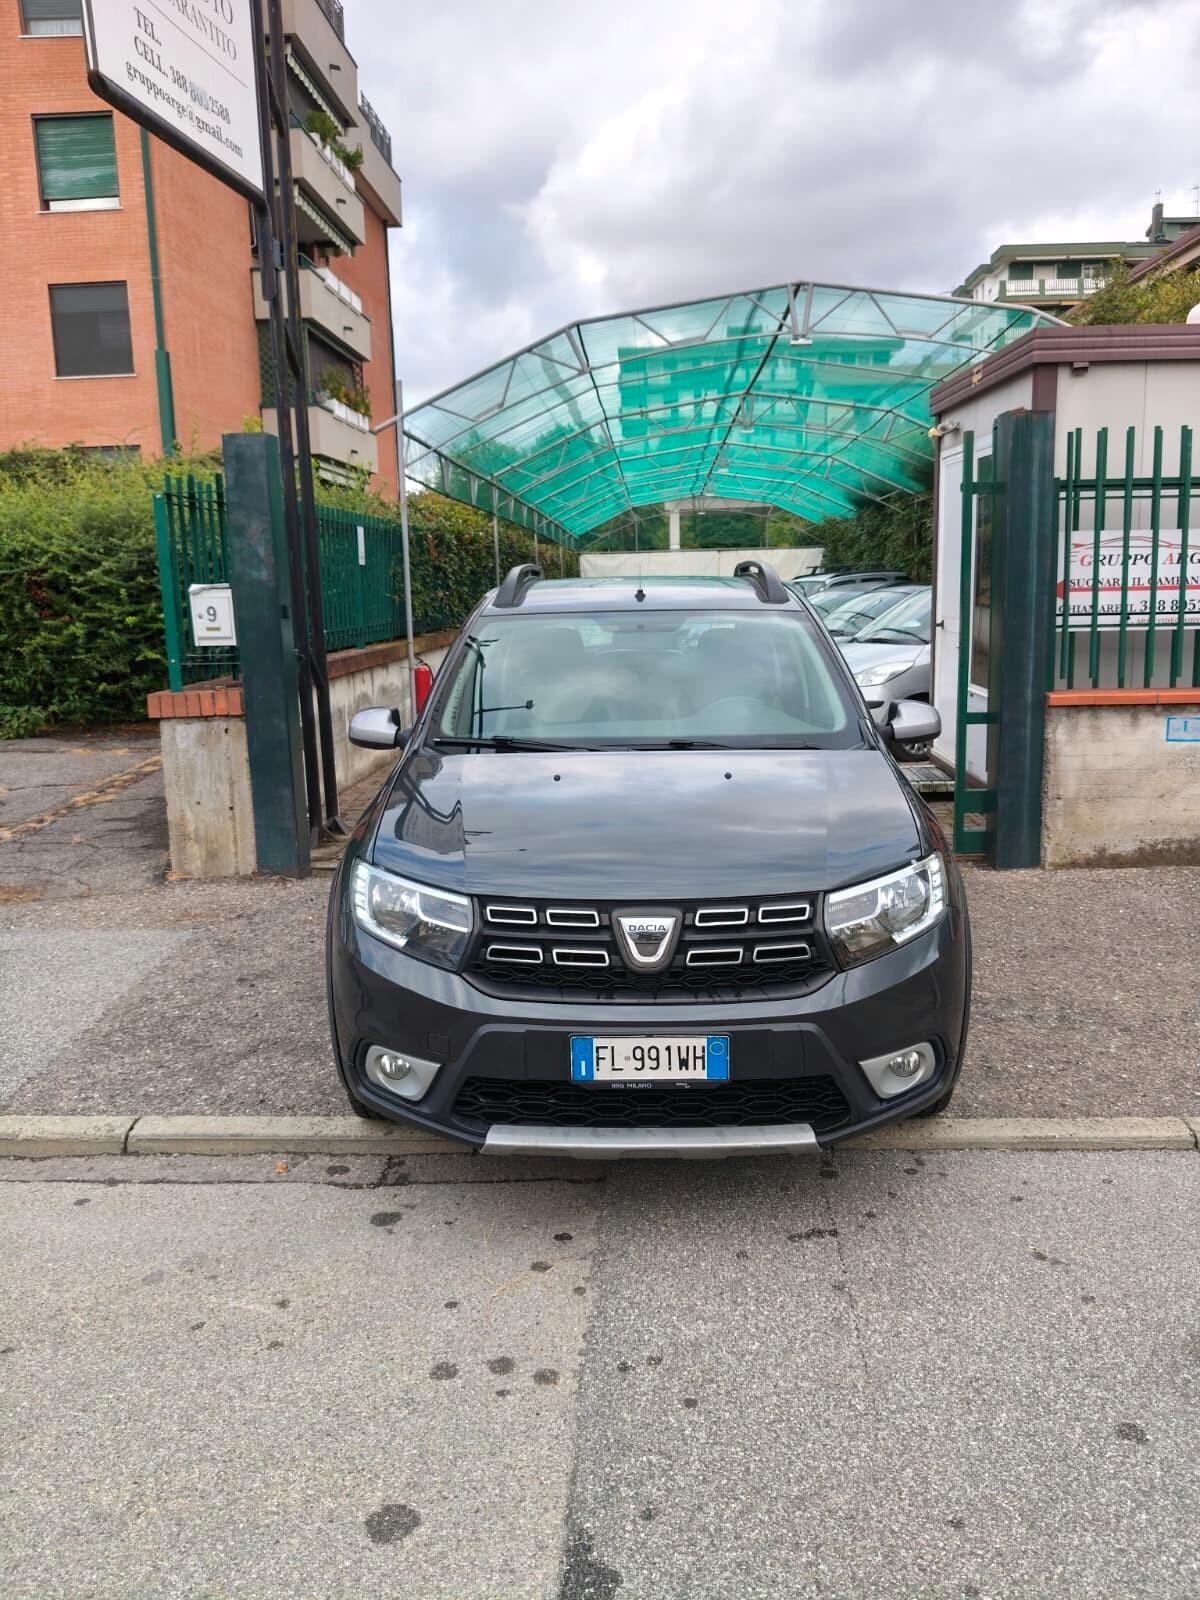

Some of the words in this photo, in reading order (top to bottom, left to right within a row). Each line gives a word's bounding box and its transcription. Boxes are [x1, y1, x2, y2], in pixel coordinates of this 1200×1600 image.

[133, 6, 162, 46] TEL.
[169, 0, 237, 60] ARANTITO
[134, 36, 168, 77] CELL.
[170, 65, 187, 93] 388
[125, 61, 243, 158] gruppoarge@gmail.com
[207, 605, 217, 622] 9
[628, 924, 667, 932] DACIA
